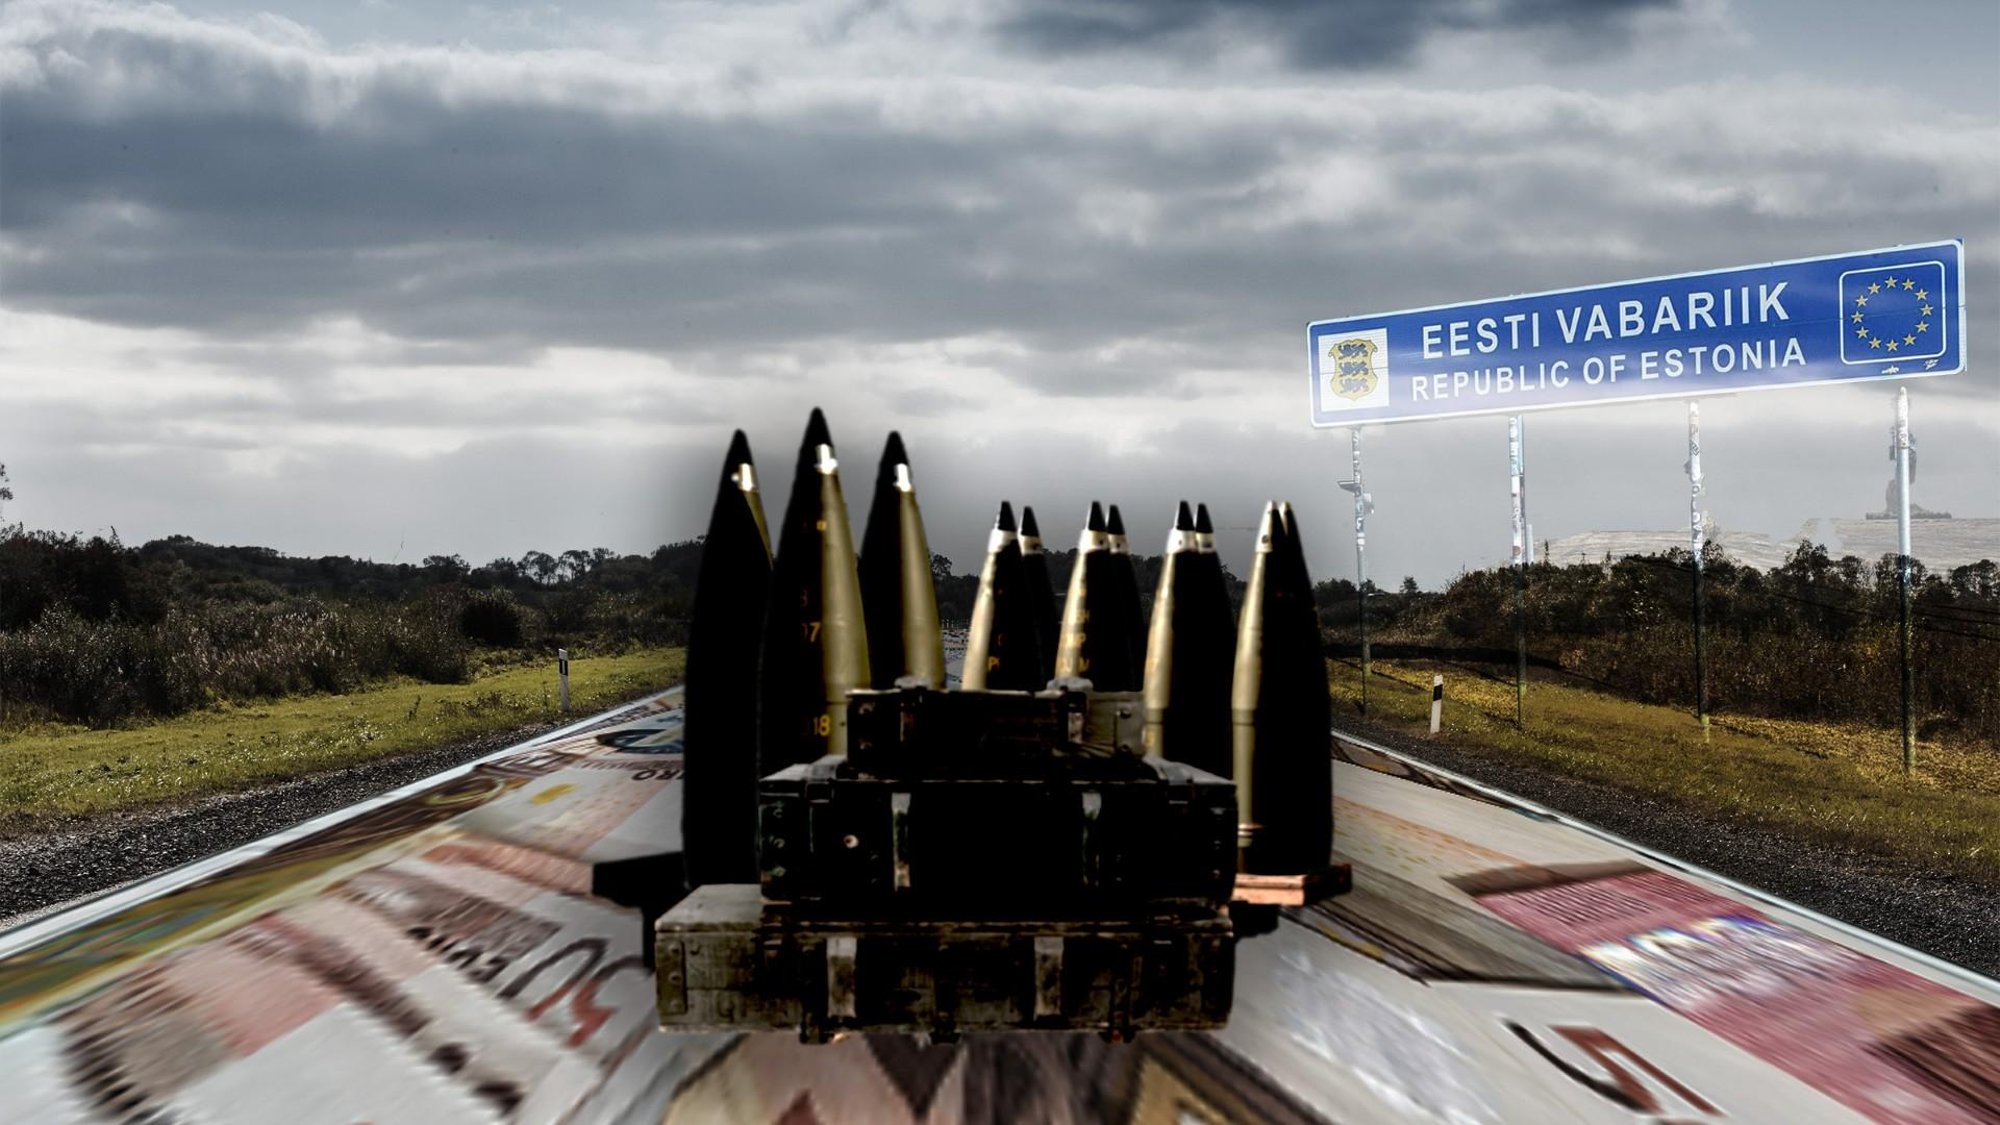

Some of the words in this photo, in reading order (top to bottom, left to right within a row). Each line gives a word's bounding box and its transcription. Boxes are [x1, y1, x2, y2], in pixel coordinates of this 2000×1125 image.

[1422, 311, 1540, 360] EESTI
[1556, 281, 1789, 344] VABARIIK
[1411, 360, 1569, 401] REPUBLIC
[1582, 354, 1626, 386] OF
[1641, 337, 1806, 380] ESTONIA
